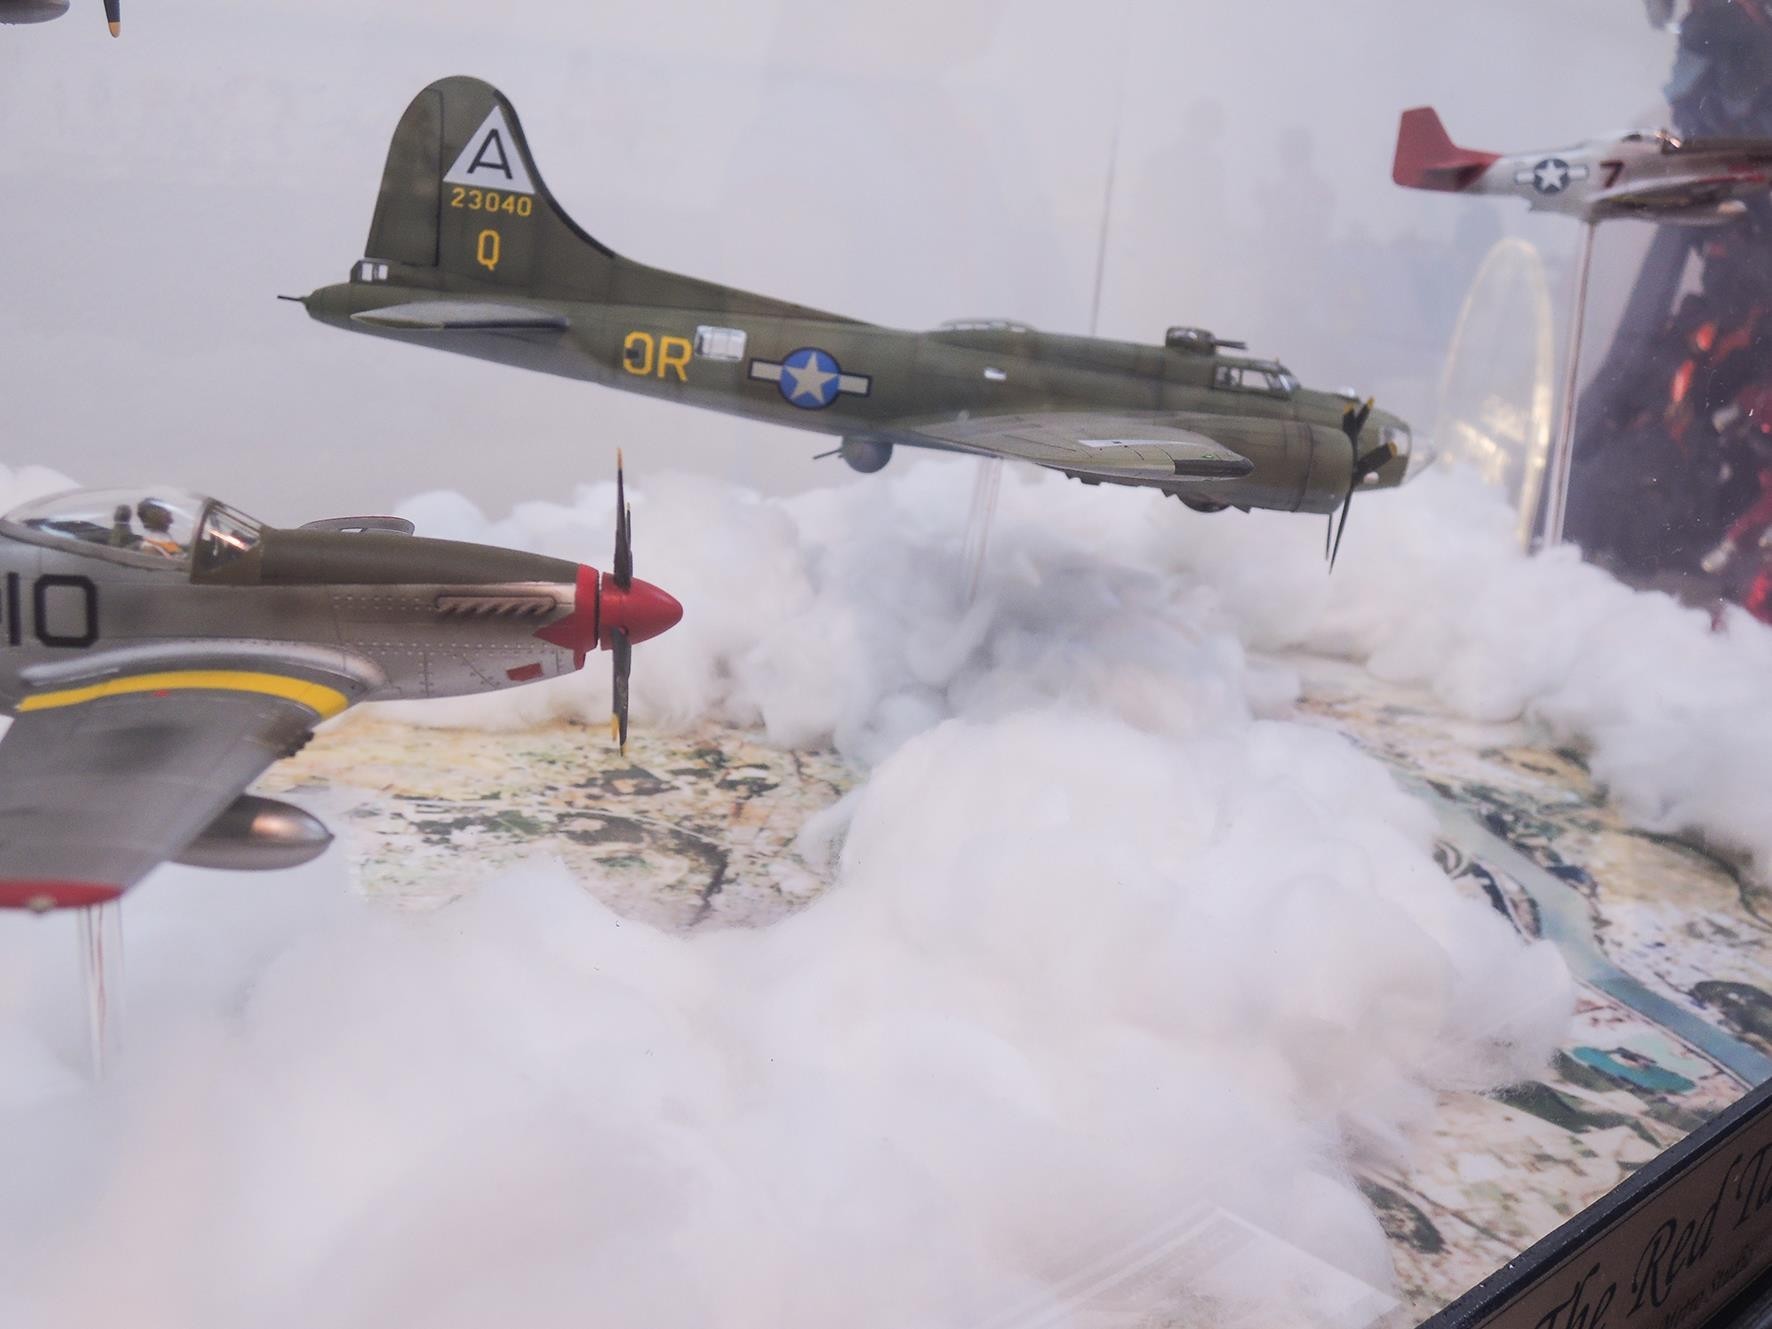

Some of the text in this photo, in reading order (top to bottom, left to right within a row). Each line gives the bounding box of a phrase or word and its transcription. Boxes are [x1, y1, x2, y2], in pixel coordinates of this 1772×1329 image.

[466, 128, 513, 180] A
[1599, 160, 1625, 189] 7
[450, 186, 532, 217] 23040
[476, 229, 501, 271] Q
[7, 571, 99, 649] 10
[1626, 1150, 1743, 1319] Red
